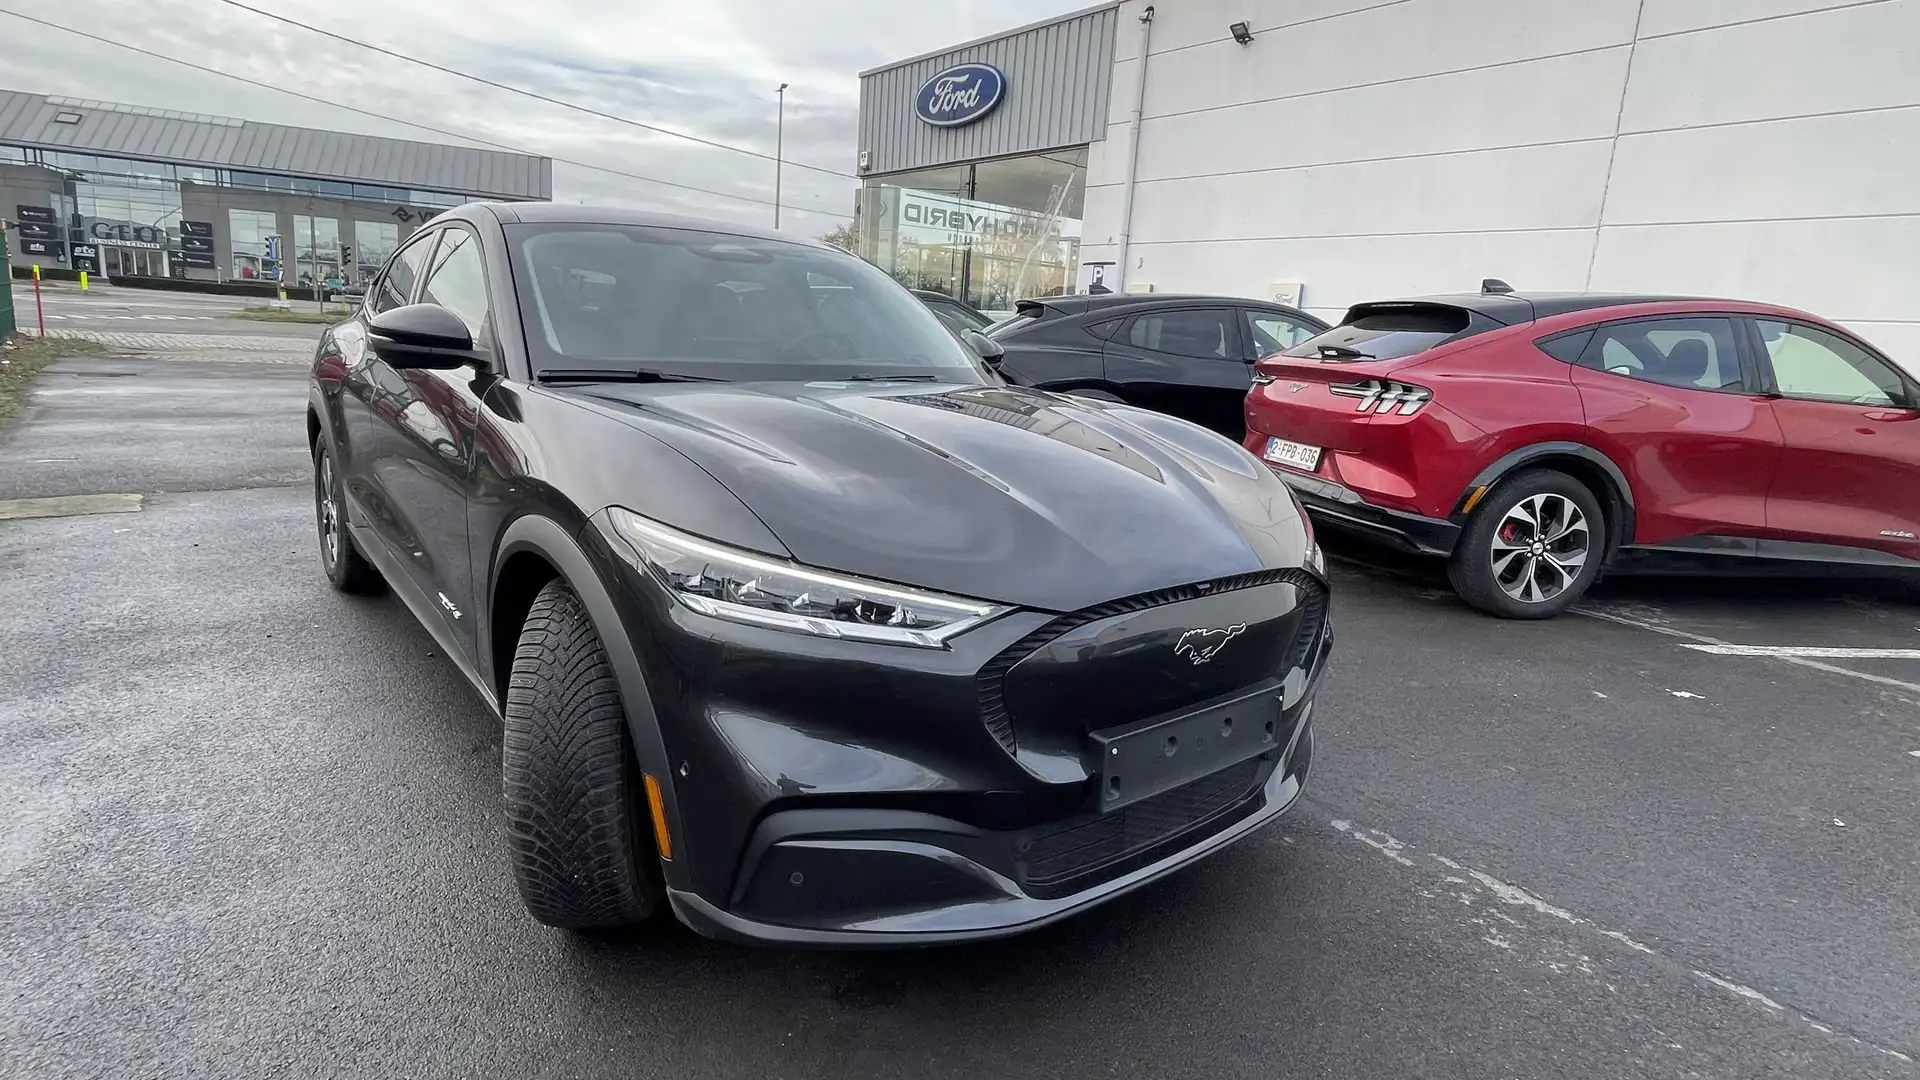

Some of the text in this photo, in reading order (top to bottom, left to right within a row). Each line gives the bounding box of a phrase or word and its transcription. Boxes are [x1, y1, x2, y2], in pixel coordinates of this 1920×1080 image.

[929, 74, 982, 114] Ford
[1093, 266, 1103, 283] P
[1271, 441, 1318, 464] 2-FPB-036
